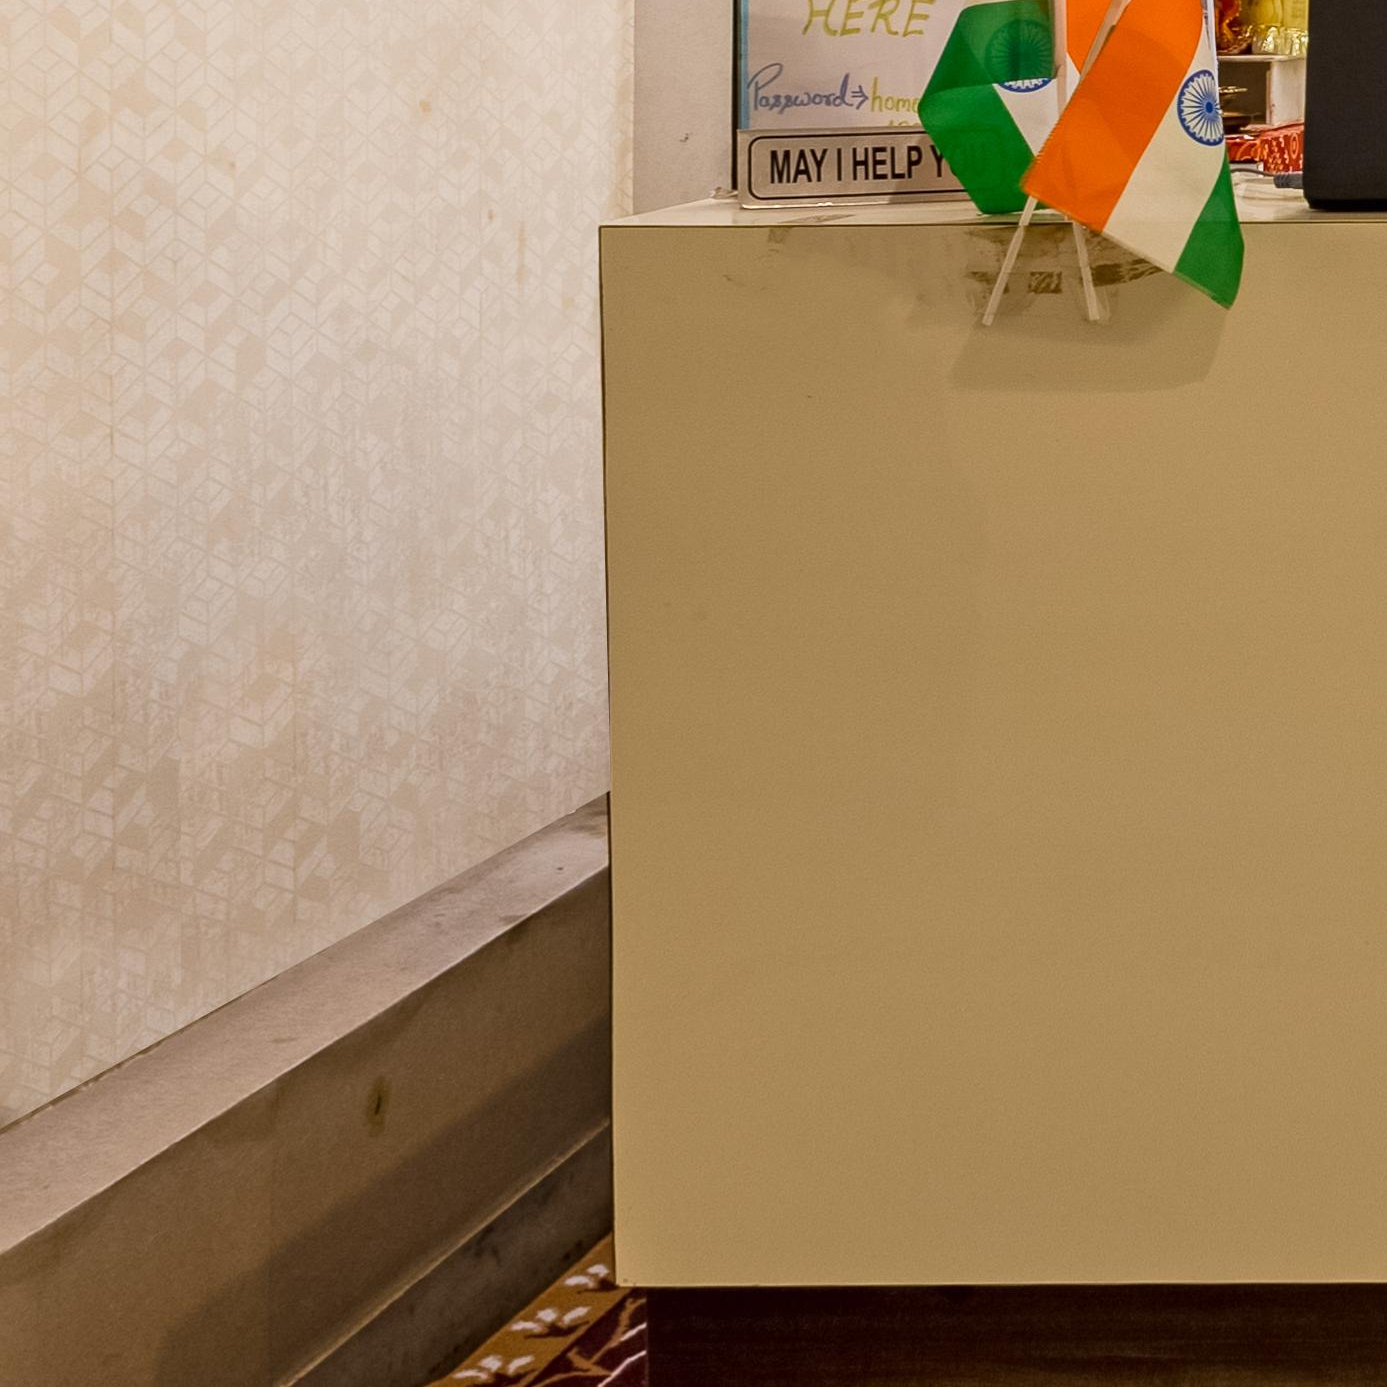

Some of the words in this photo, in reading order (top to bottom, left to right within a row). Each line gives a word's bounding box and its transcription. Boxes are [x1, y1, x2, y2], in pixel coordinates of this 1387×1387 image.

[747, 63, 854, 114] Password
[770, 148, 828, 184] MAY
[836, 147, 842, 182] I
[852, 145, 923, 181] HELP
[930, 144, 945, 178] Y
